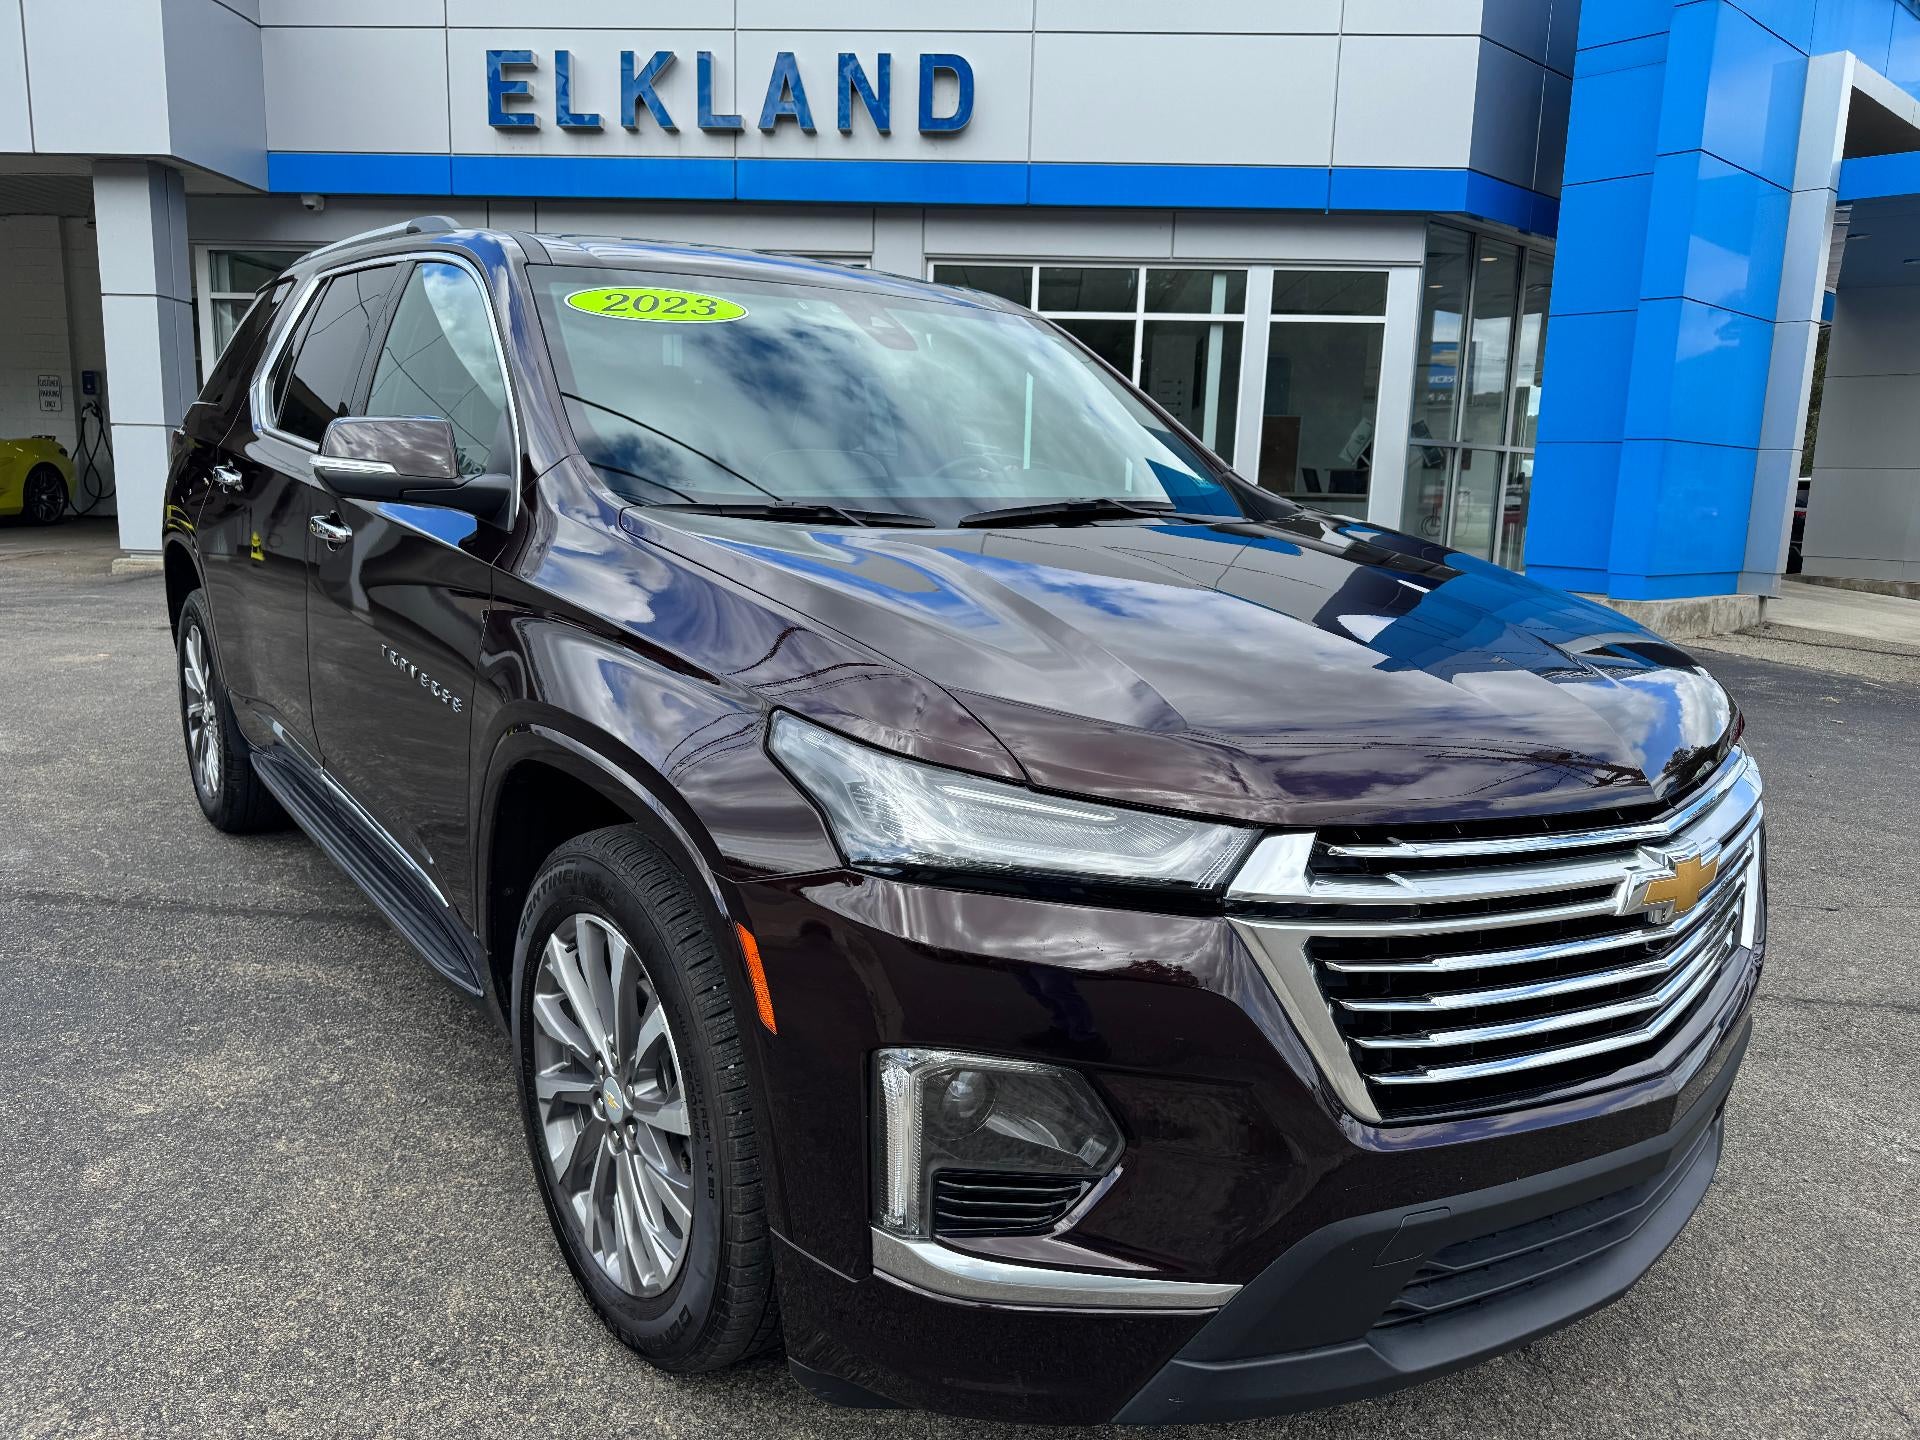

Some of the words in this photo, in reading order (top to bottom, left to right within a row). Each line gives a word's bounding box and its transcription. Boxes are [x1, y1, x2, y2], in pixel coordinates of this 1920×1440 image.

[486, 49, 975, 134] ELKLAND
[601, 293, 718, 316] 2023
[381, 643, 463, 713] TRAVERSE
